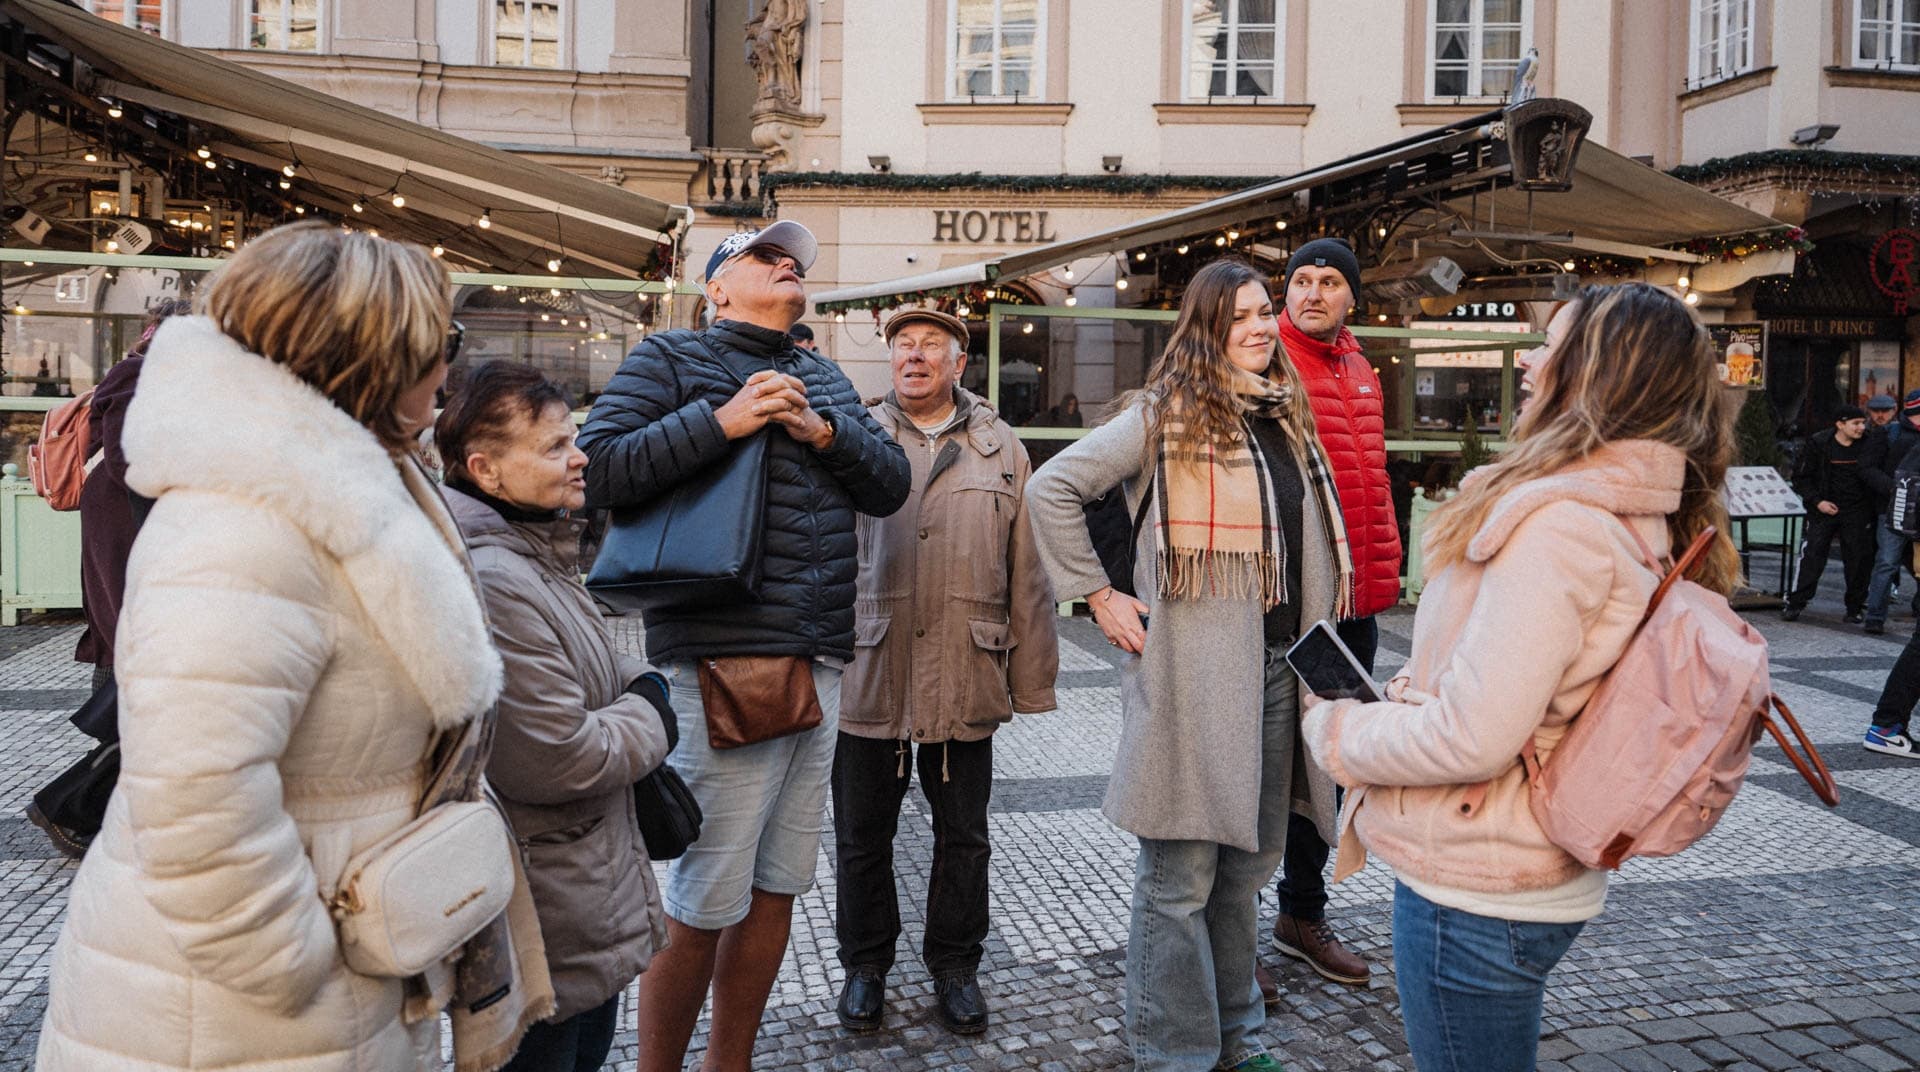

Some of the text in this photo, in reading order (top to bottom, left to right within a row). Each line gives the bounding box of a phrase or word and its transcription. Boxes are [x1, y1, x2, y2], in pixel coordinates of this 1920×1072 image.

[933, 210, 1057, 242] HOTEL
[1448, 302, 1516, 316] STRO
[1767, 319, 1808, 333] HOTEL
[1814, 320, 1823, 334] U
[1829, 319, 1875, 335] PRINCE
